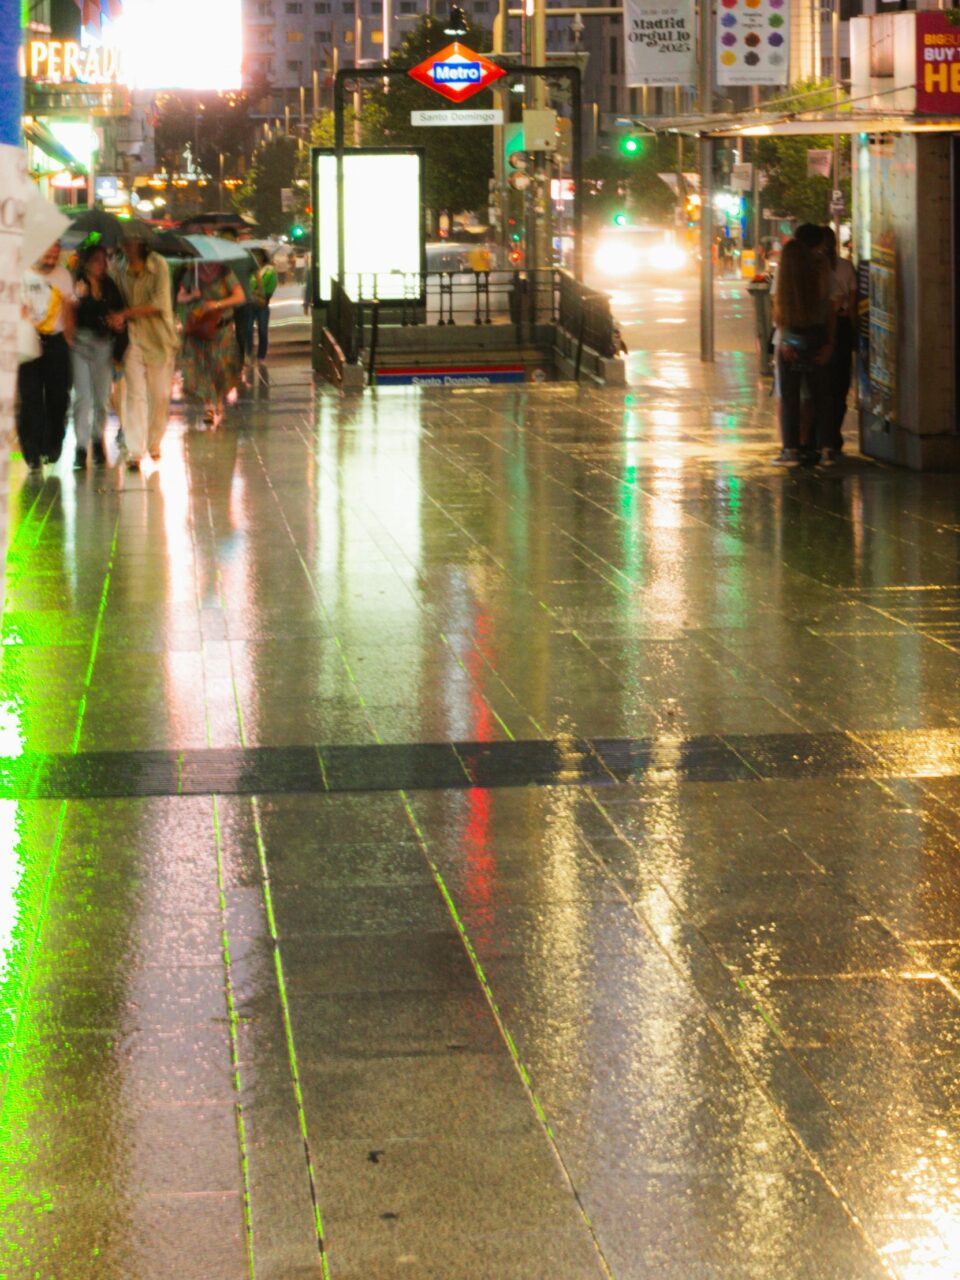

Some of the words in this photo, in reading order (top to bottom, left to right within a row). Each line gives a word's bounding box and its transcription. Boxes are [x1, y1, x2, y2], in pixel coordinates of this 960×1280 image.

[632, 17, 685, 31] Madrid
[924, 47, 955, 62] BUY
[435, 66, 479, 80] Metro
[420, 112, 448, 122] Santo
[451, 111, 495, 124] Domingo
